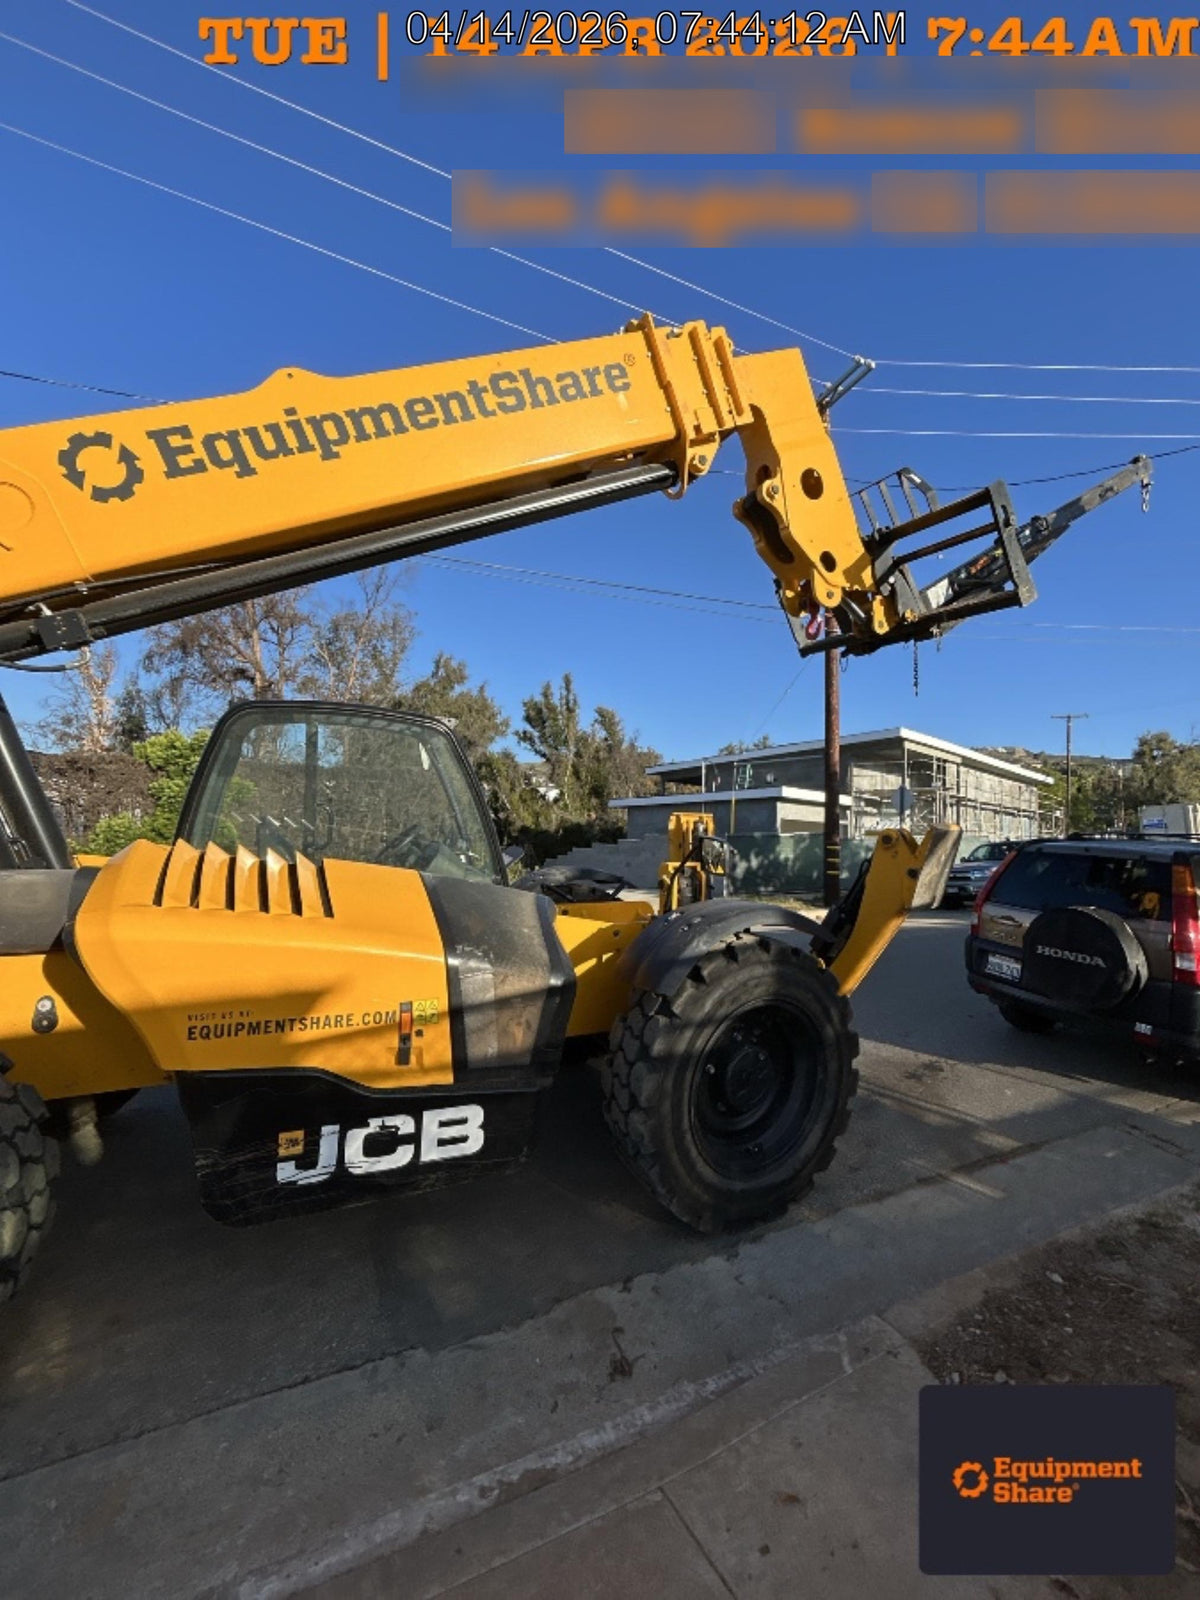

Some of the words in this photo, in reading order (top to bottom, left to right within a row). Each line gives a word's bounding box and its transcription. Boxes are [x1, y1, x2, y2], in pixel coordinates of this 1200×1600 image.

[147, 360, 632, 479] EquipmentShare
[1035, 944, 1107, 968] HONDA
[187, 1009, 398, 1041] EQUIPMENTSHARE.COM
[276, 1104, 485, 1185] JCB
